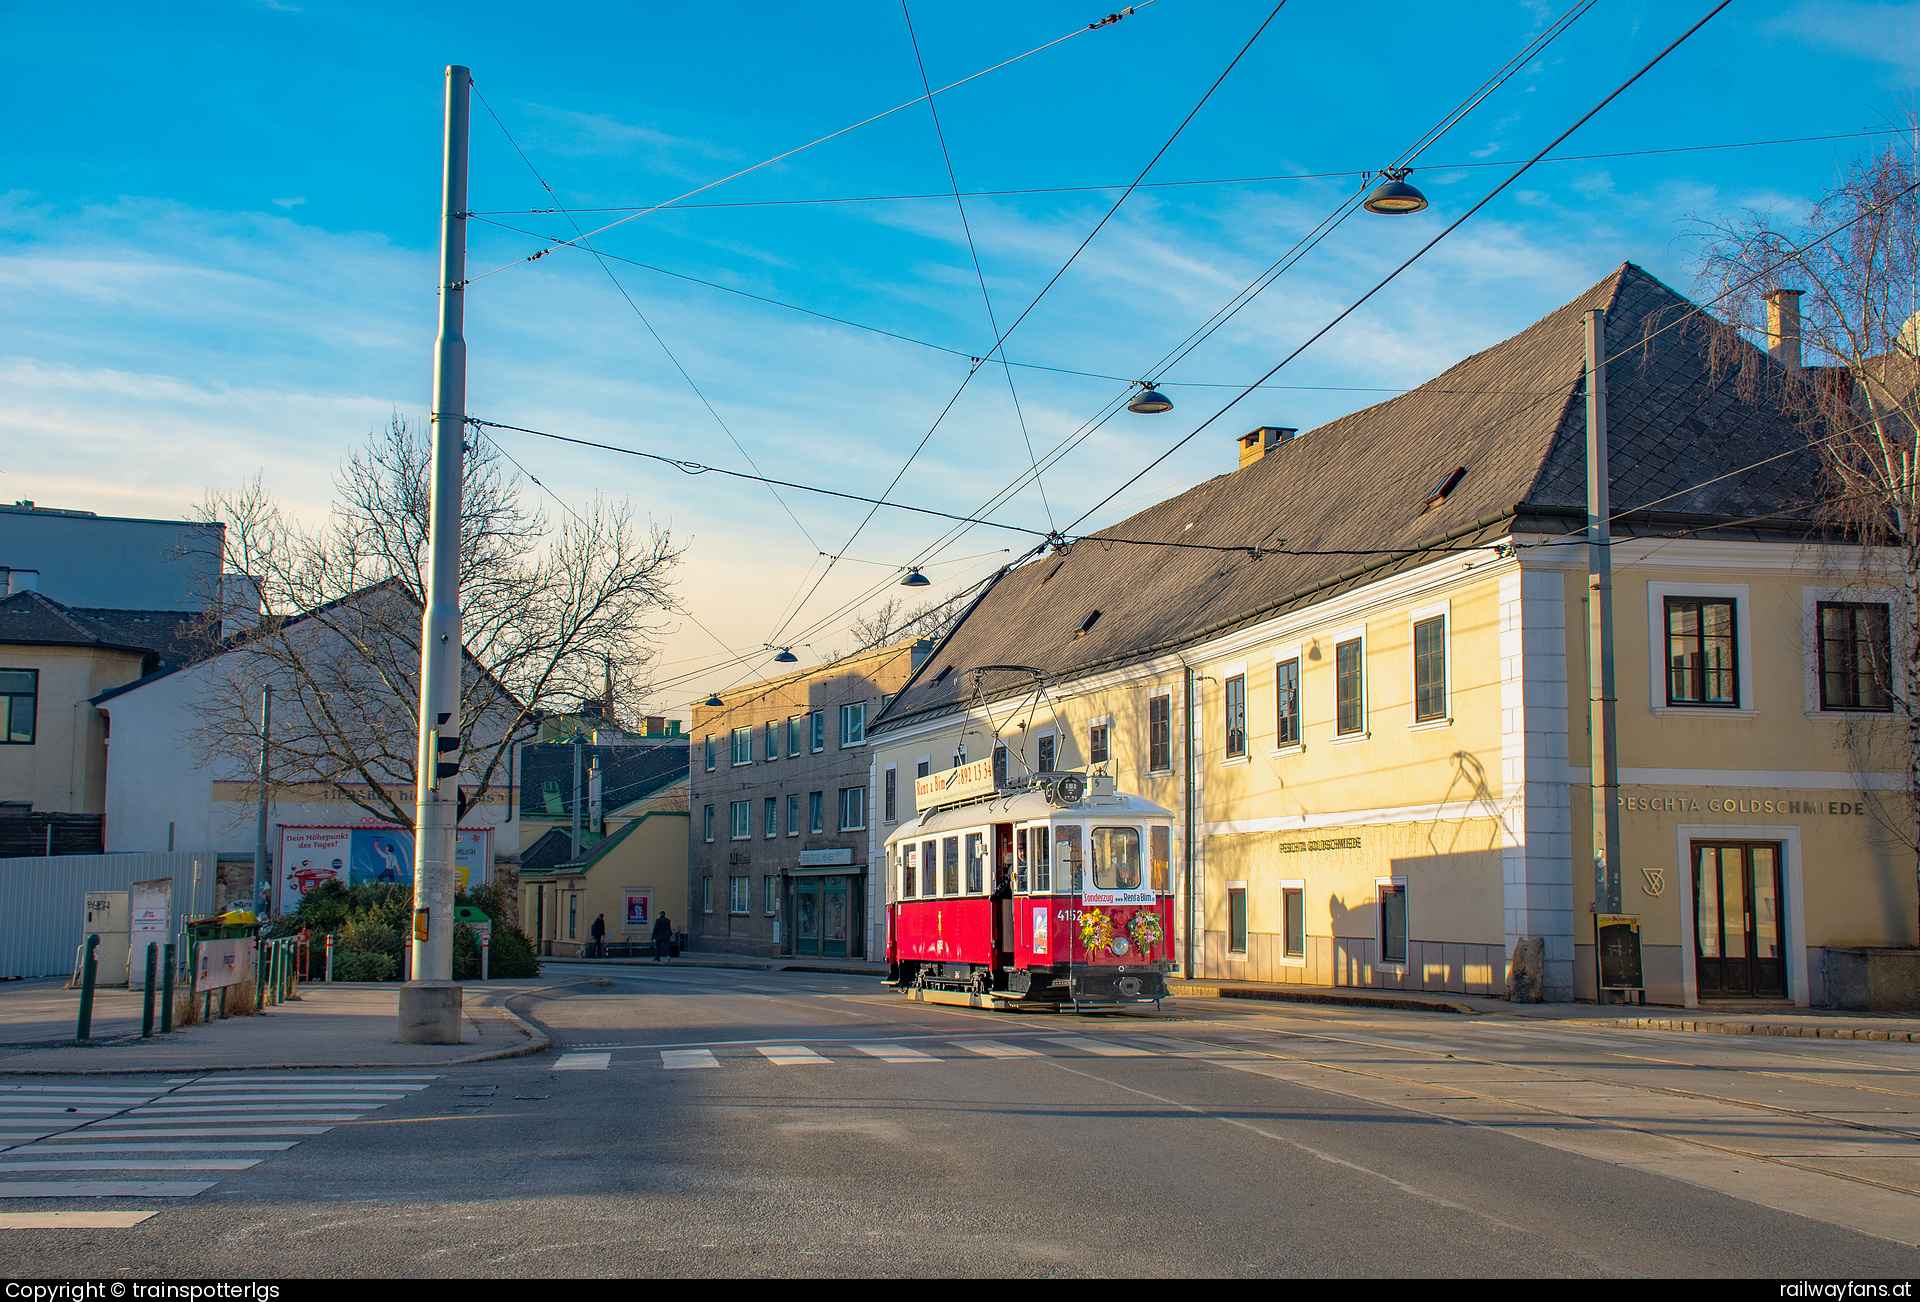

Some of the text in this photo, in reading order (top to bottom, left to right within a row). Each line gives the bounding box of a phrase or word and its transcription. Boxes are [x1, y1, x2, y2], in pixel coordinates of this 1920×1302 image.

[916, 780, 929, 797] Rent
[934, 775, 946, 791] Bim
[1708, 798, 1865, 816] GOLDSCHMIEDE
[306, 832, 350, 842] Höhepunkt
[313, 840, 339, 850] Tages!
[1083, 893, 1114, 904] Sonderzug
[1057, 909, 1083, 922] 4152
